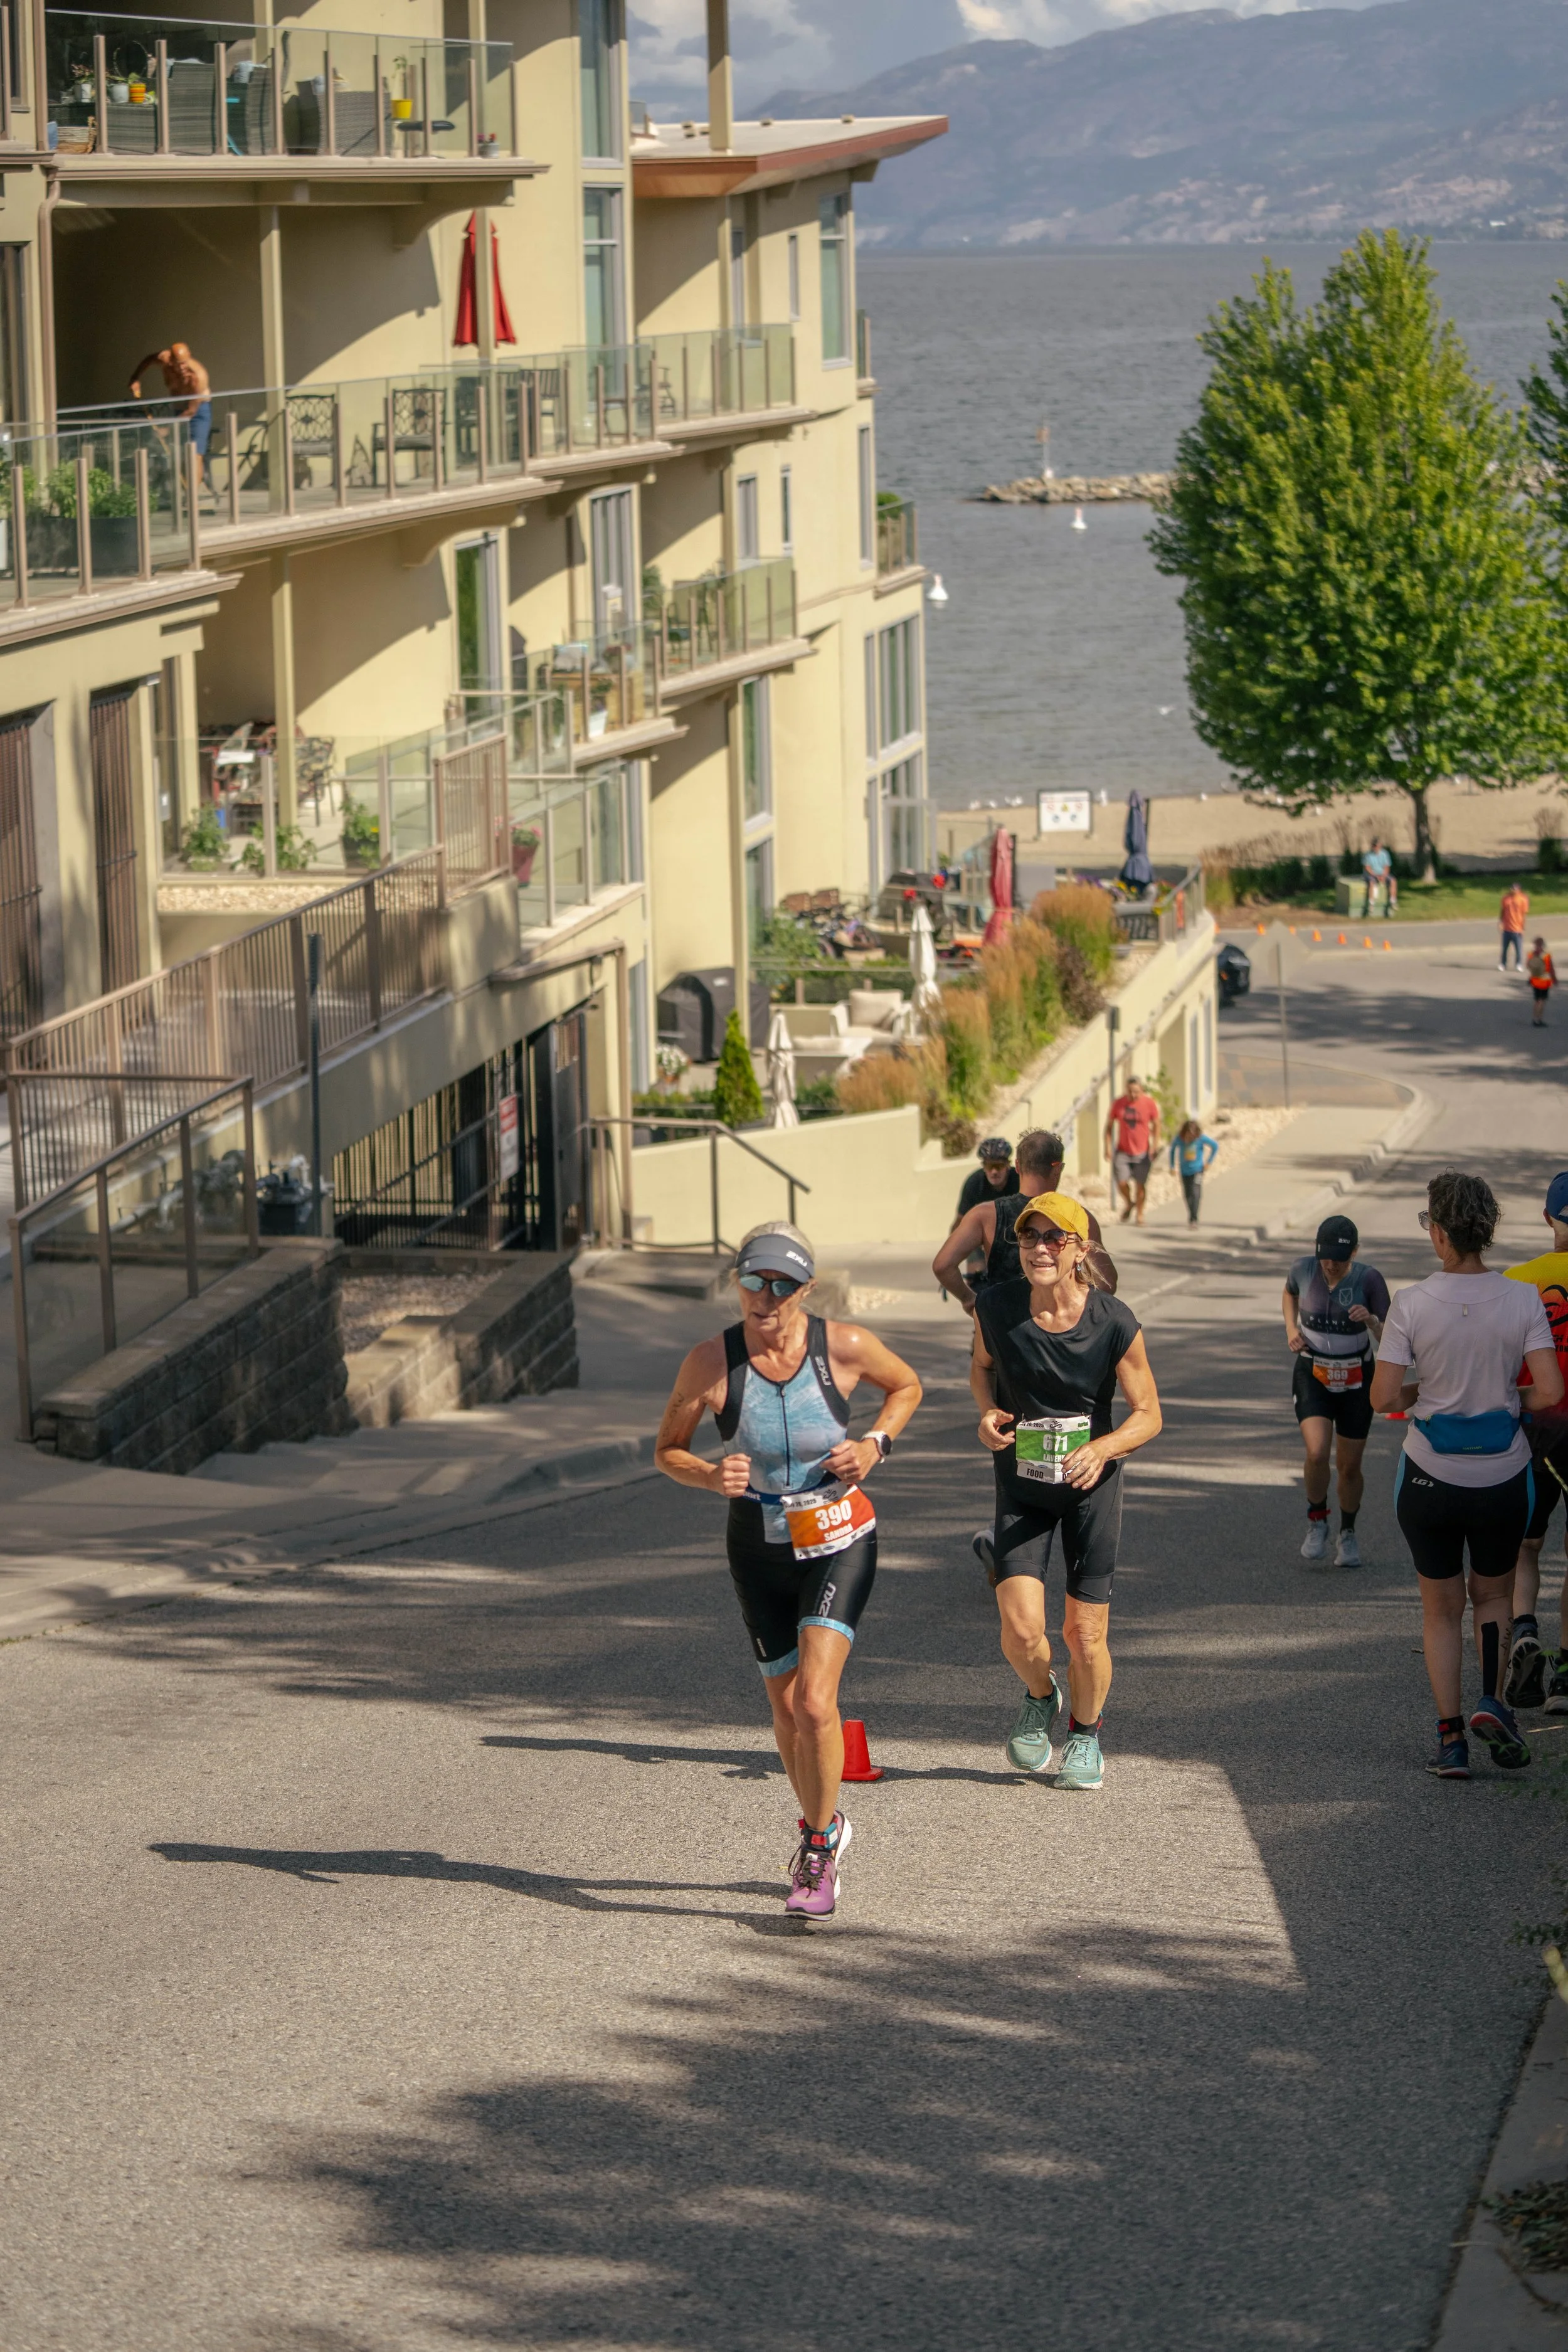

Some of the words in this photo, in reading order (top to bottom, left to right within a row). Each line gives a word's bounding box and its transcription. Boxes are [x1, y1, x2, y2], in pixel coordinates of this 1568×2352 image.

[786, 1250, 808, 1267] 2XU
[1310, 1316, 1345, 1326] PLANT
[815, 1355, 832, 1385] 2XU
[1327, 1369, 1348, 1380] 369
[1042, 1434, 1069, 1452] 671
[1026, 1468, 1044, 1479] FOOD
[815, 1499, 852, 1530] 390
[823, 1523, 854, 1542] SANDRA
[818, 1582, 836, 1618] 2XU
